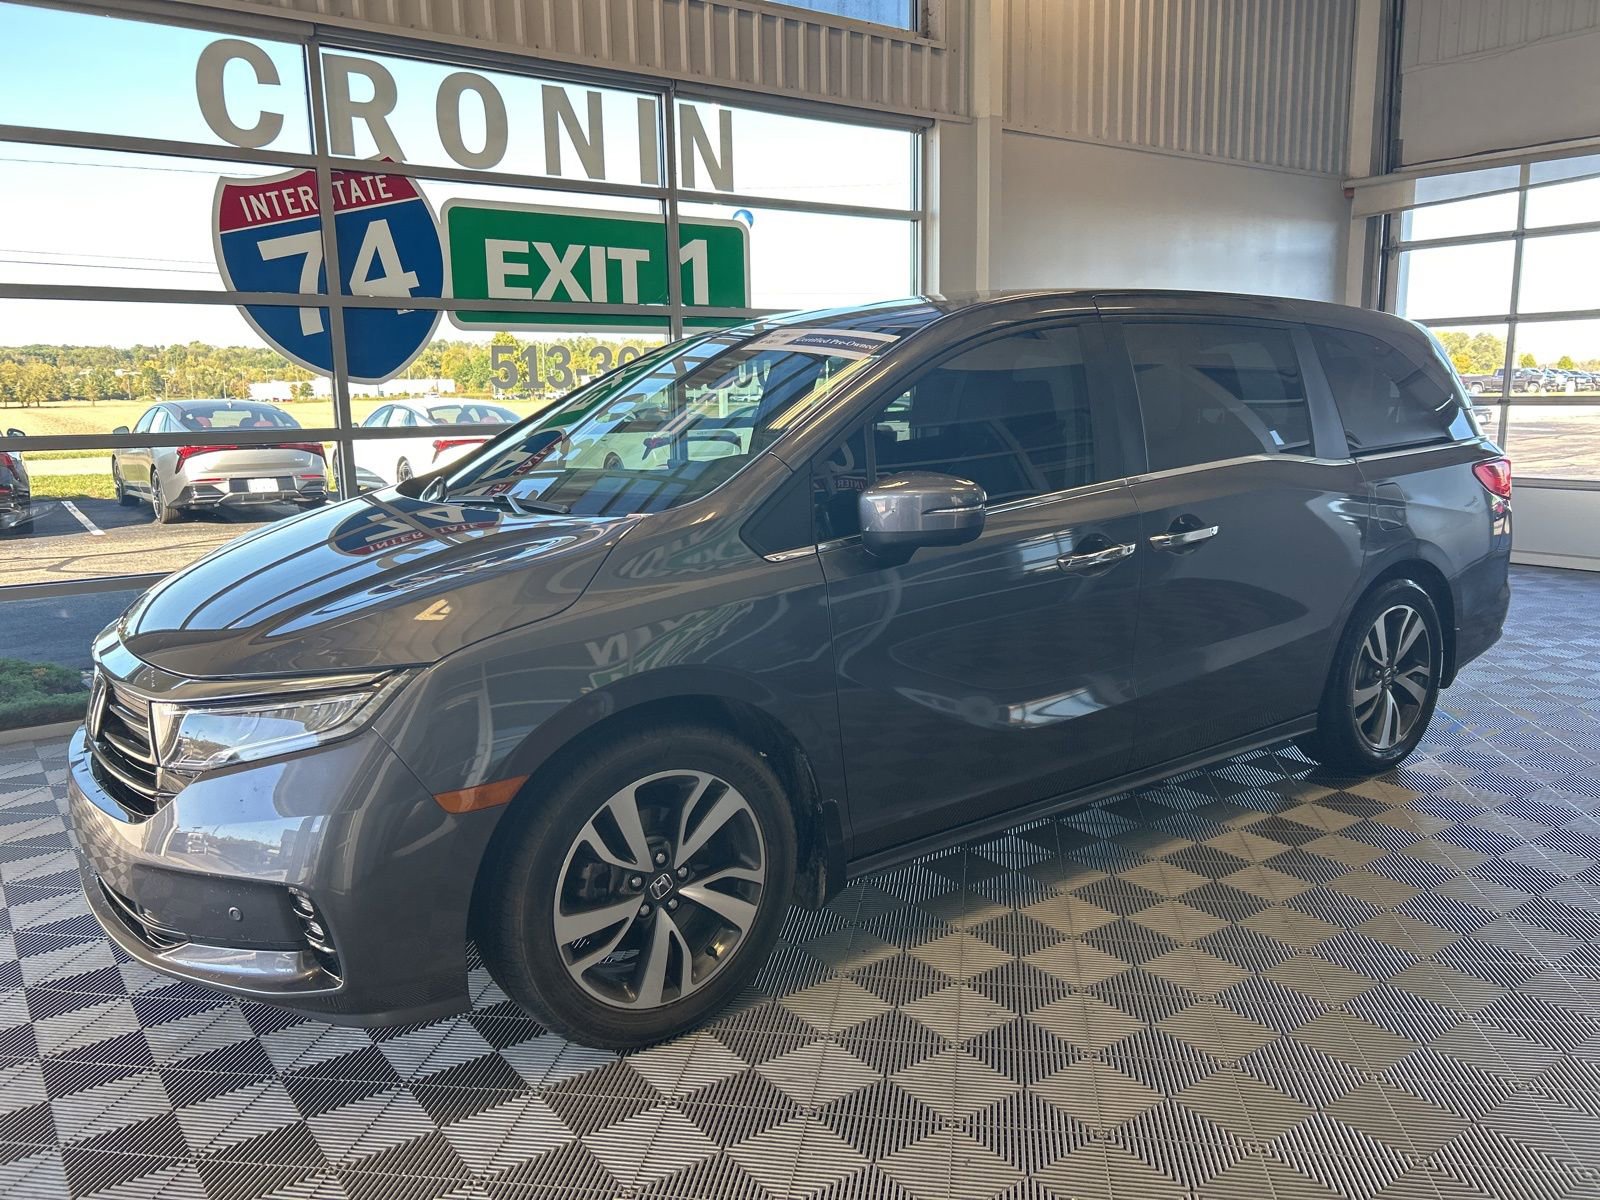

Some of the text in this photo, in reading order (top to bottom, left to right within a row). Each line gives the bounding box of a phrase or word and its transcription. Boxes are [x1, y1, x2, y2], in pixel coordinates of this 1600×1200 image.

[196, 39, 734, 192] CRONIN
[240, 175, 393, 222] INTERTATE
[257, 219, 420, 336] 74
[485, 239, 709, 305] EXIT 1
[795, 337, 831, 346] Certified
[830, 339, 878, 350] Pre-Owned
